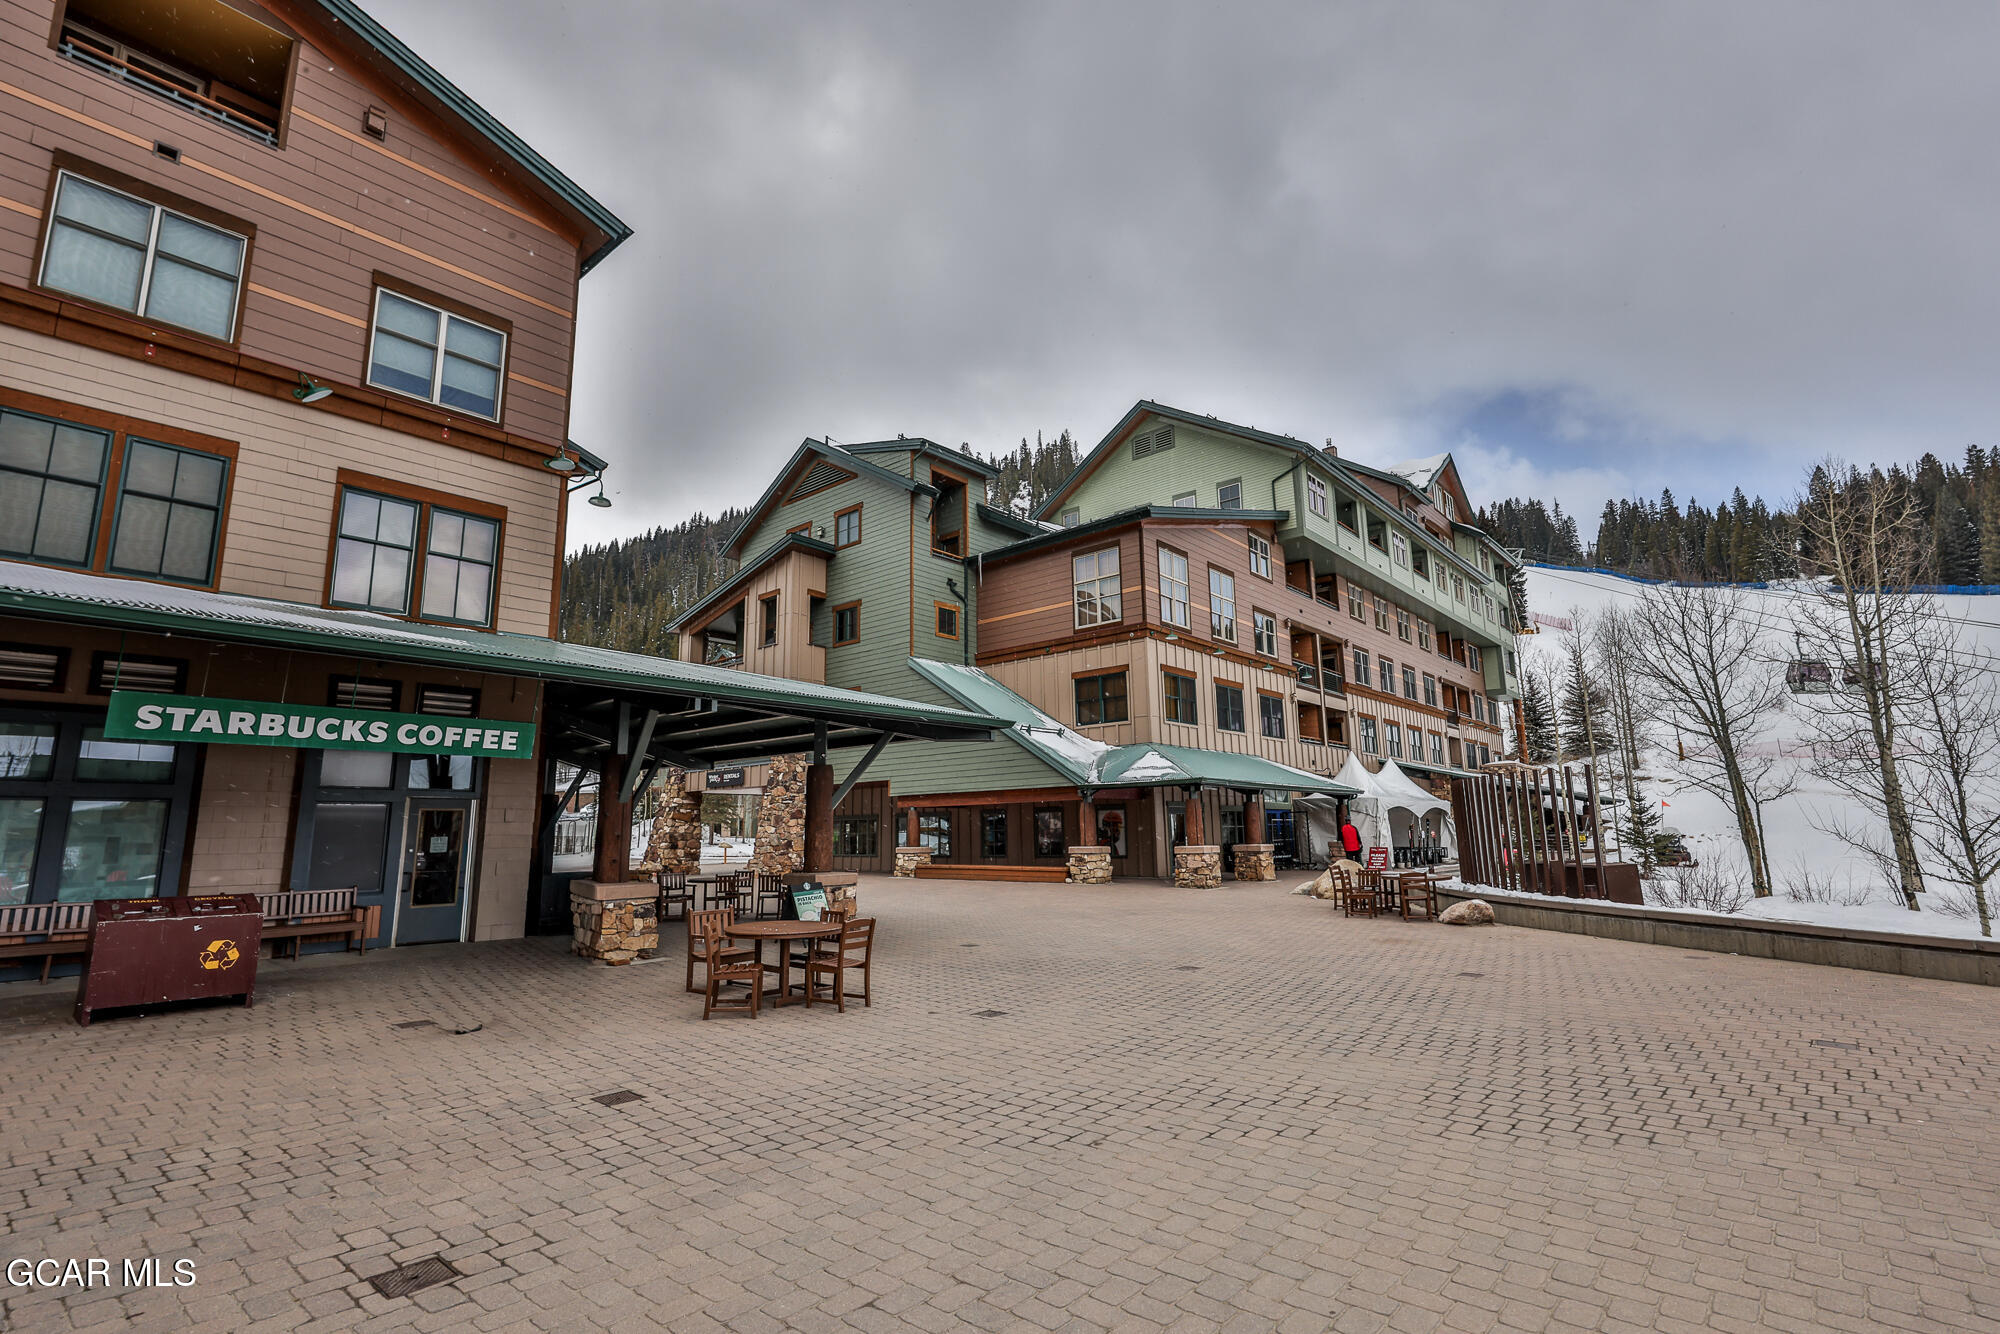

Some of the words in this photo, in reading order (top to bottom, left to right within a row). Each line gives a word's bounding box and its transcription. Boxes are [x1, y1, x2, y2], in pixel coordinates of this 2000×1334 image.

[134, 704, 390, 744] STARBUCKS
[396, 723, 520, 751] COFFEE
[796, 894, 823, 902] PISTACHIO
